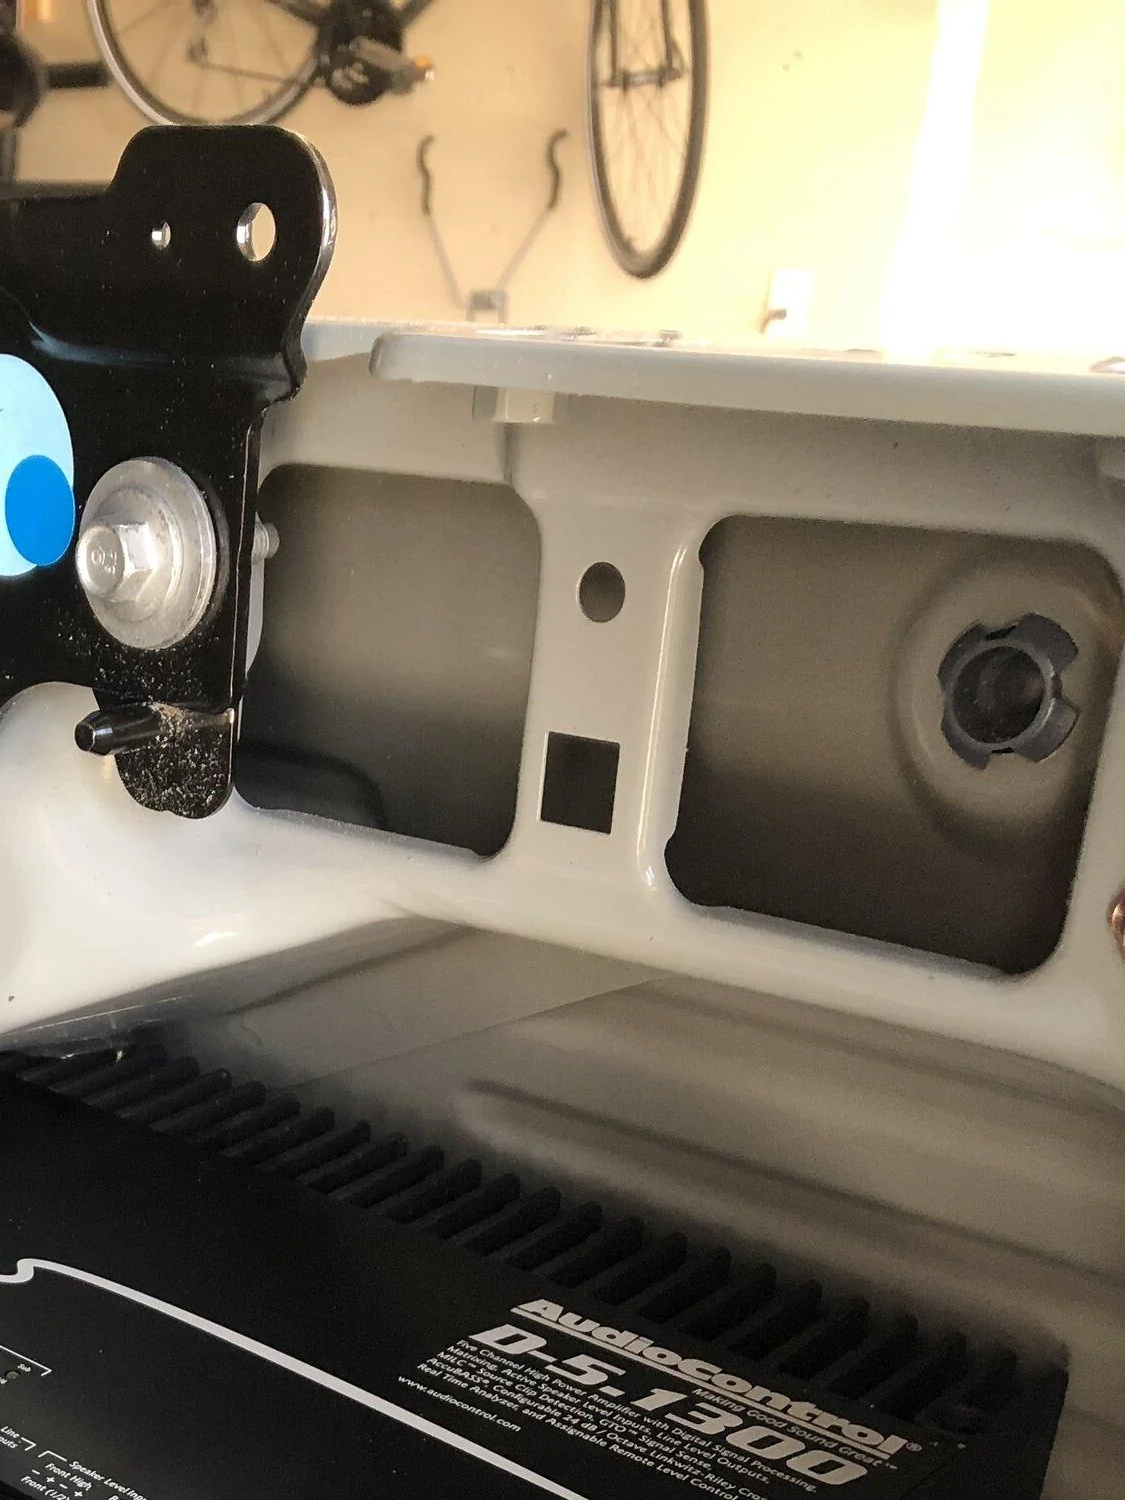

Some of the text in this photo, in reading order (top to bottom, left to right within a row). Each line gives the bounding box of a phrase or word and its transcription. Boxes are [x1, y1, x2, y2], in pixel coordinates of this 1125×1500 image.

[0, 1424, 20, 1440] Line
[398, 1376, 521, 1432] www.audiocontrol.com
[417, 1363, 443, 1377] Real
[442, 1373, 468, 1389] Time
[522, 1408, 546, 1421] and
[546, 1417, 607, 1447] Assignable
[609, 1444, 655, 1467] Remote
[656, 1464, 689, 1481] Level
[690, 1478, 739, 1500] Control
[456, 1339, 478, 1351] Five
[480, 1349, 525, 1370] Channel
[524, 1367, 550, 1383] High
[552, 1378, 587, 1396] Power
[588, 1394, 641, 1418] Amplifier
[643, 1416, 670, 1431] with
[672, 1427, 711, 1447] Digital
[712, 1443, 750, 1463] Signal
[468, 1324, 868, 1486] D-5.1300
[476, 1368, 513, 1387] Source
[515, 1384, 537, 1397] Clip
[638, 1435, 675, 1453] Signal
[493, 1384, 562, 1417] Configurable
[562, 1414, 579, 1425] 24
[581, 1420, 598, 1432] dB
[606, 1433, 648, 1453] Octave
[650, 1451, 736, 1490] Linkwitz-Riley
[501, 1368, 537, 1386] Active
[538, 1383, 581, 1404] Speaker
[582, 1400, 612, 1416] Level
[656, 1432, 682, 1446] Line
[684, 1443, 714, 1460] Level
[691, 1388, 744, 1412] Making
[747, 1410, 788, 1428] Good
[787, 1425, 838, 1449] Sound
[20, 1475, 48, 1494] Front
[45, 1462, 93, 1492] Front High
[69, 1459, 105, 1483] Speaker
[103, 1476, 131, 1494] Level
